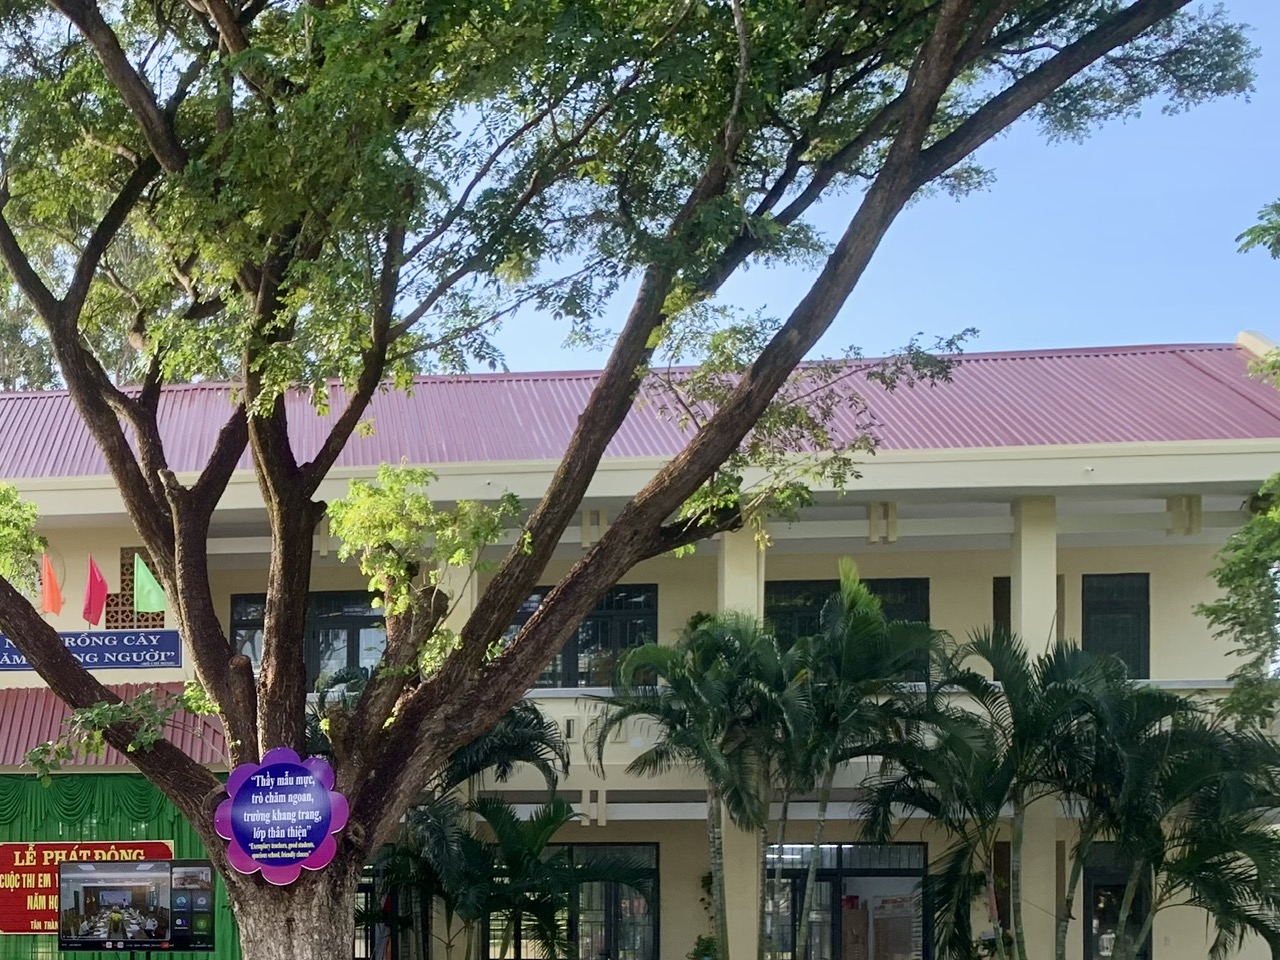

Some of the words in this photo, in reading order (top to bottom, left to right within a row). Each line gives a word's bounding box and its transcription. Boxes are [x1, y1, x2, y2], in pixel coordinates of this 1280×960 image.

[61, 632, 117, 646] RỒNG
[123, 633, 160, 646] CÂY
[277, 771, 294, 786] mẫu
[295, 775, 315, 788] mực,
[252, 791, 264, 804] trò
[265, 791, 286, 804] chăm
[288, 793, 314, 806] ngoan,
[243, 809, 271, 825] trường
[272, 809, 296, 824] khang
[298, 809, 322, 823] trang,
[253, 826, 266, 842] lớp
[268, 825, 285, 839] thân
[14, 844, 37, 866] LỄ
[42, 845, 91, 866] PHÁT
[0, 871, 20, 893] CUỘC
[21, 873, 36, 888] THI
[37, 873, 52, 888] EM
[26, 892, 46, 910] NĂM
[48, 894, 58, 912] HỌ
[30, 918, 42, 930] TÂN
